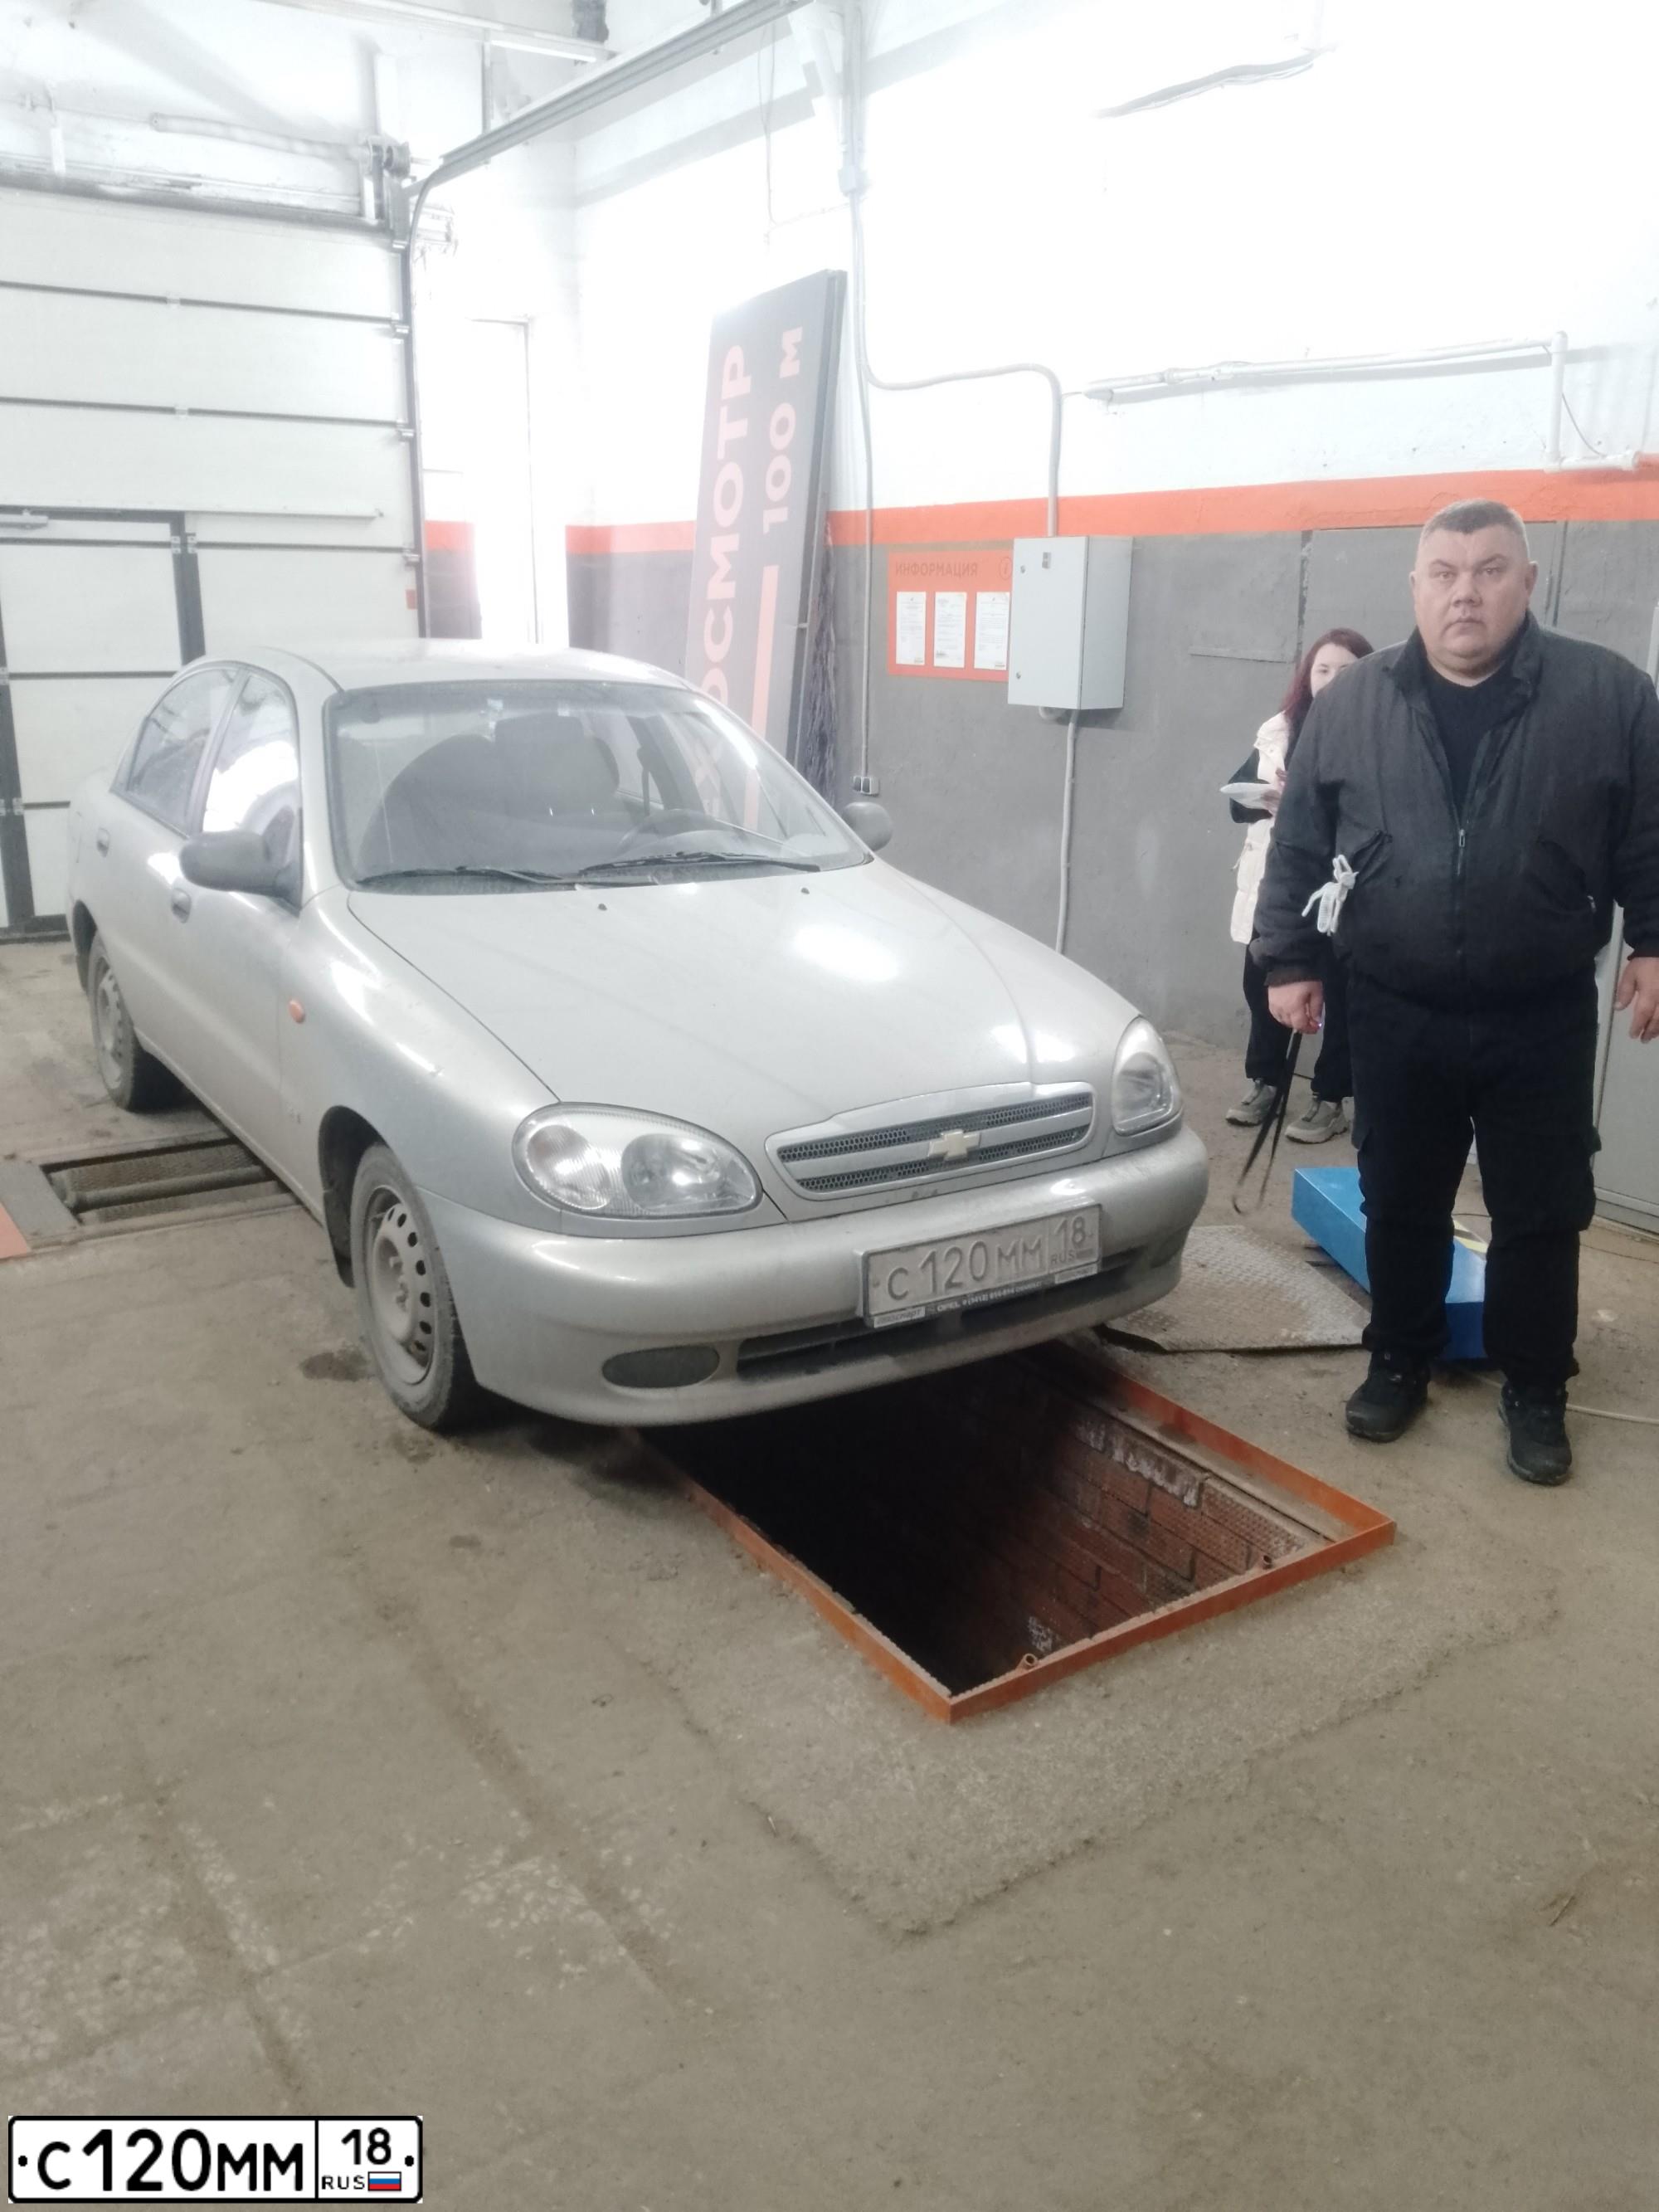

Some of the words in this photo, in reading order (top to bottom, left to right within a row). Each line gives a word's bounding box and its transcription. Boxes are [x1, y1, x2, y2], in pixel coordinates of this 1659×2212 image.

[761, 402, 796, 534] 100
[895, 562, 978, 578] ИНФОРМАЦИЯ
[1054, 1216, 1086, 1245] 18
[1050, 1251, 1076, 1265] RUS
